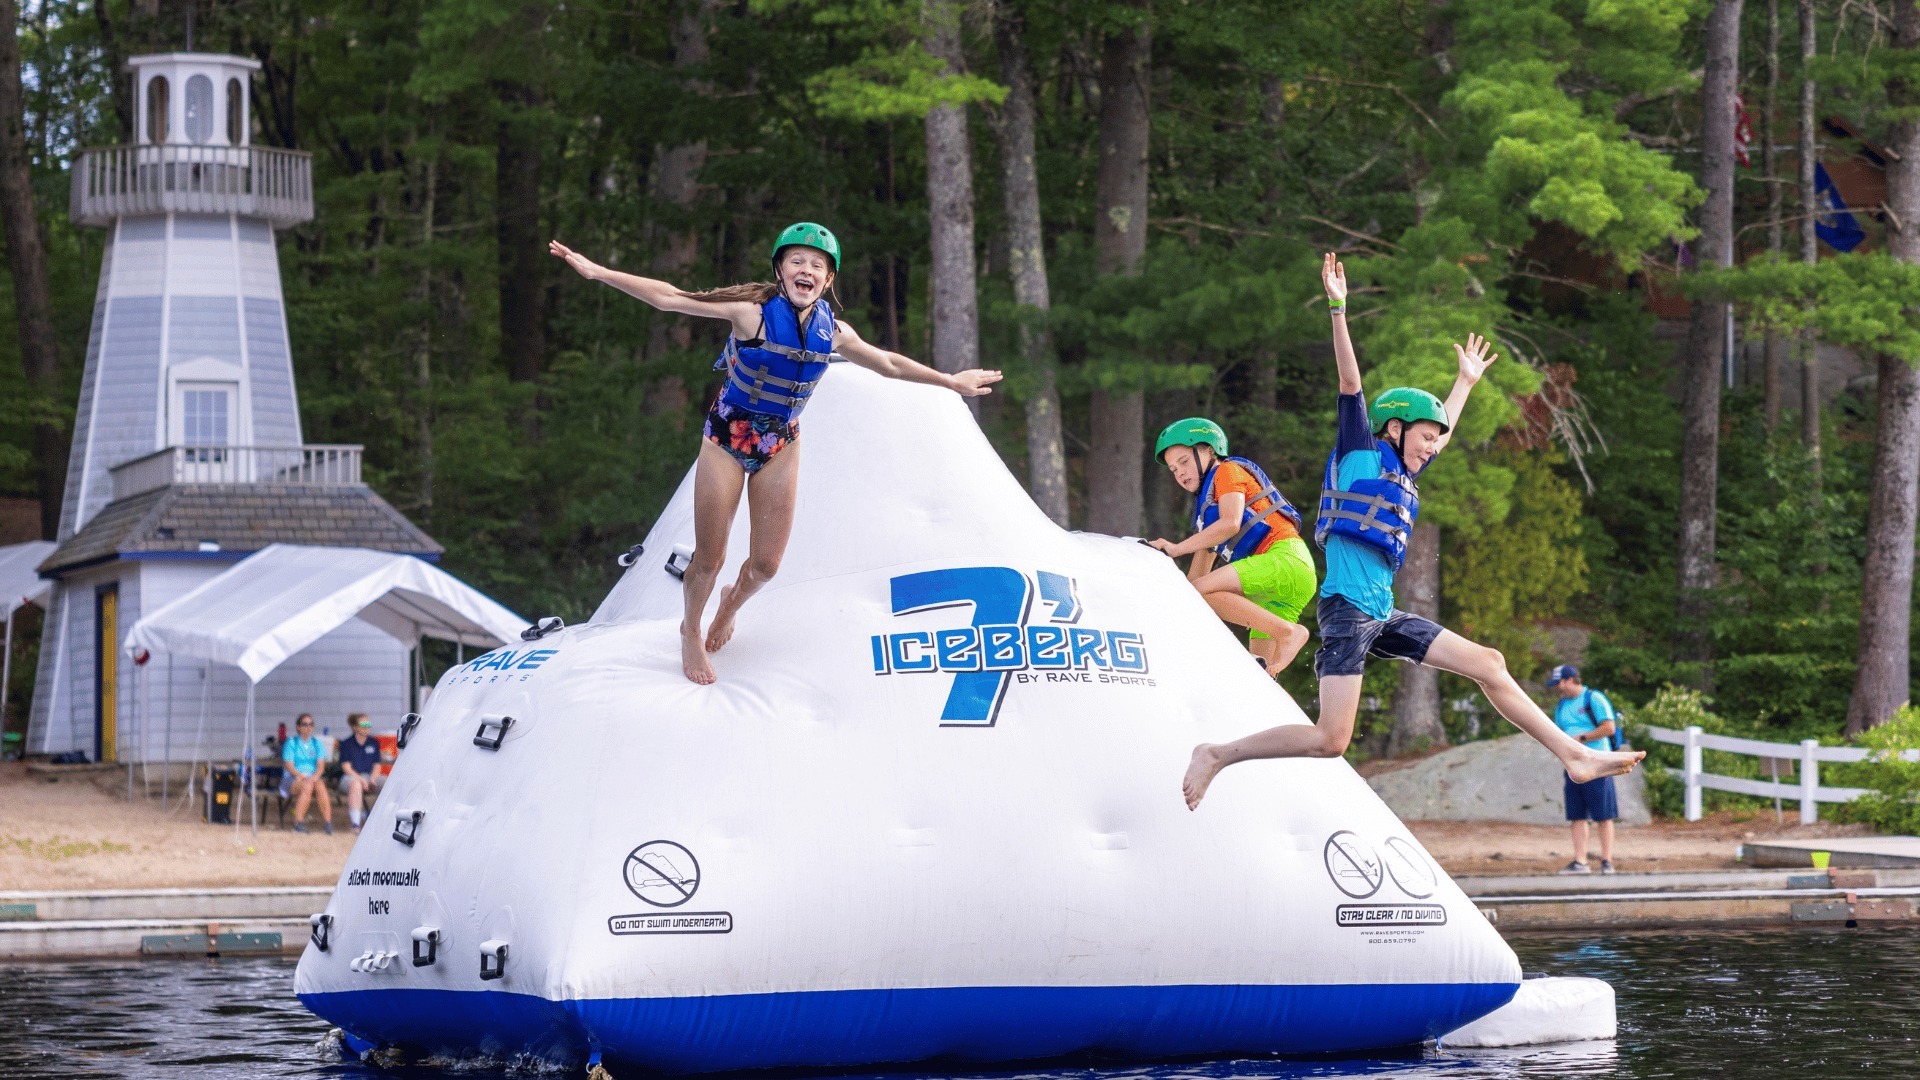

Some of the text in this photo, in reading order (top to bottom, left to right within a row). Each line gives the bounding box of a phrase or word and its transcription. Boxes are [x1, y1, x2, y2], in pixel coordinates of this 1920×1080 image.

[460, 649, 560, 673] RAVE
[448, 674, 531, 686] SPORTS
[1046, 672, 1093, 683] RAVE
[1098, 673, 1157, 687] SPORTS
[347, 868, 421, 887] attach moonwalk
[368, 896, 390, 915] here
[1340, 910, 1365, 921] STAY
[1365, 910, 1394, 920] CLEAR
[1400, 910, 1413, 920] NO
[1414, 909, 1442, 920] DIVING
[614, 917, 727, 930] DO NOT SWIM UNDERNEATH!
